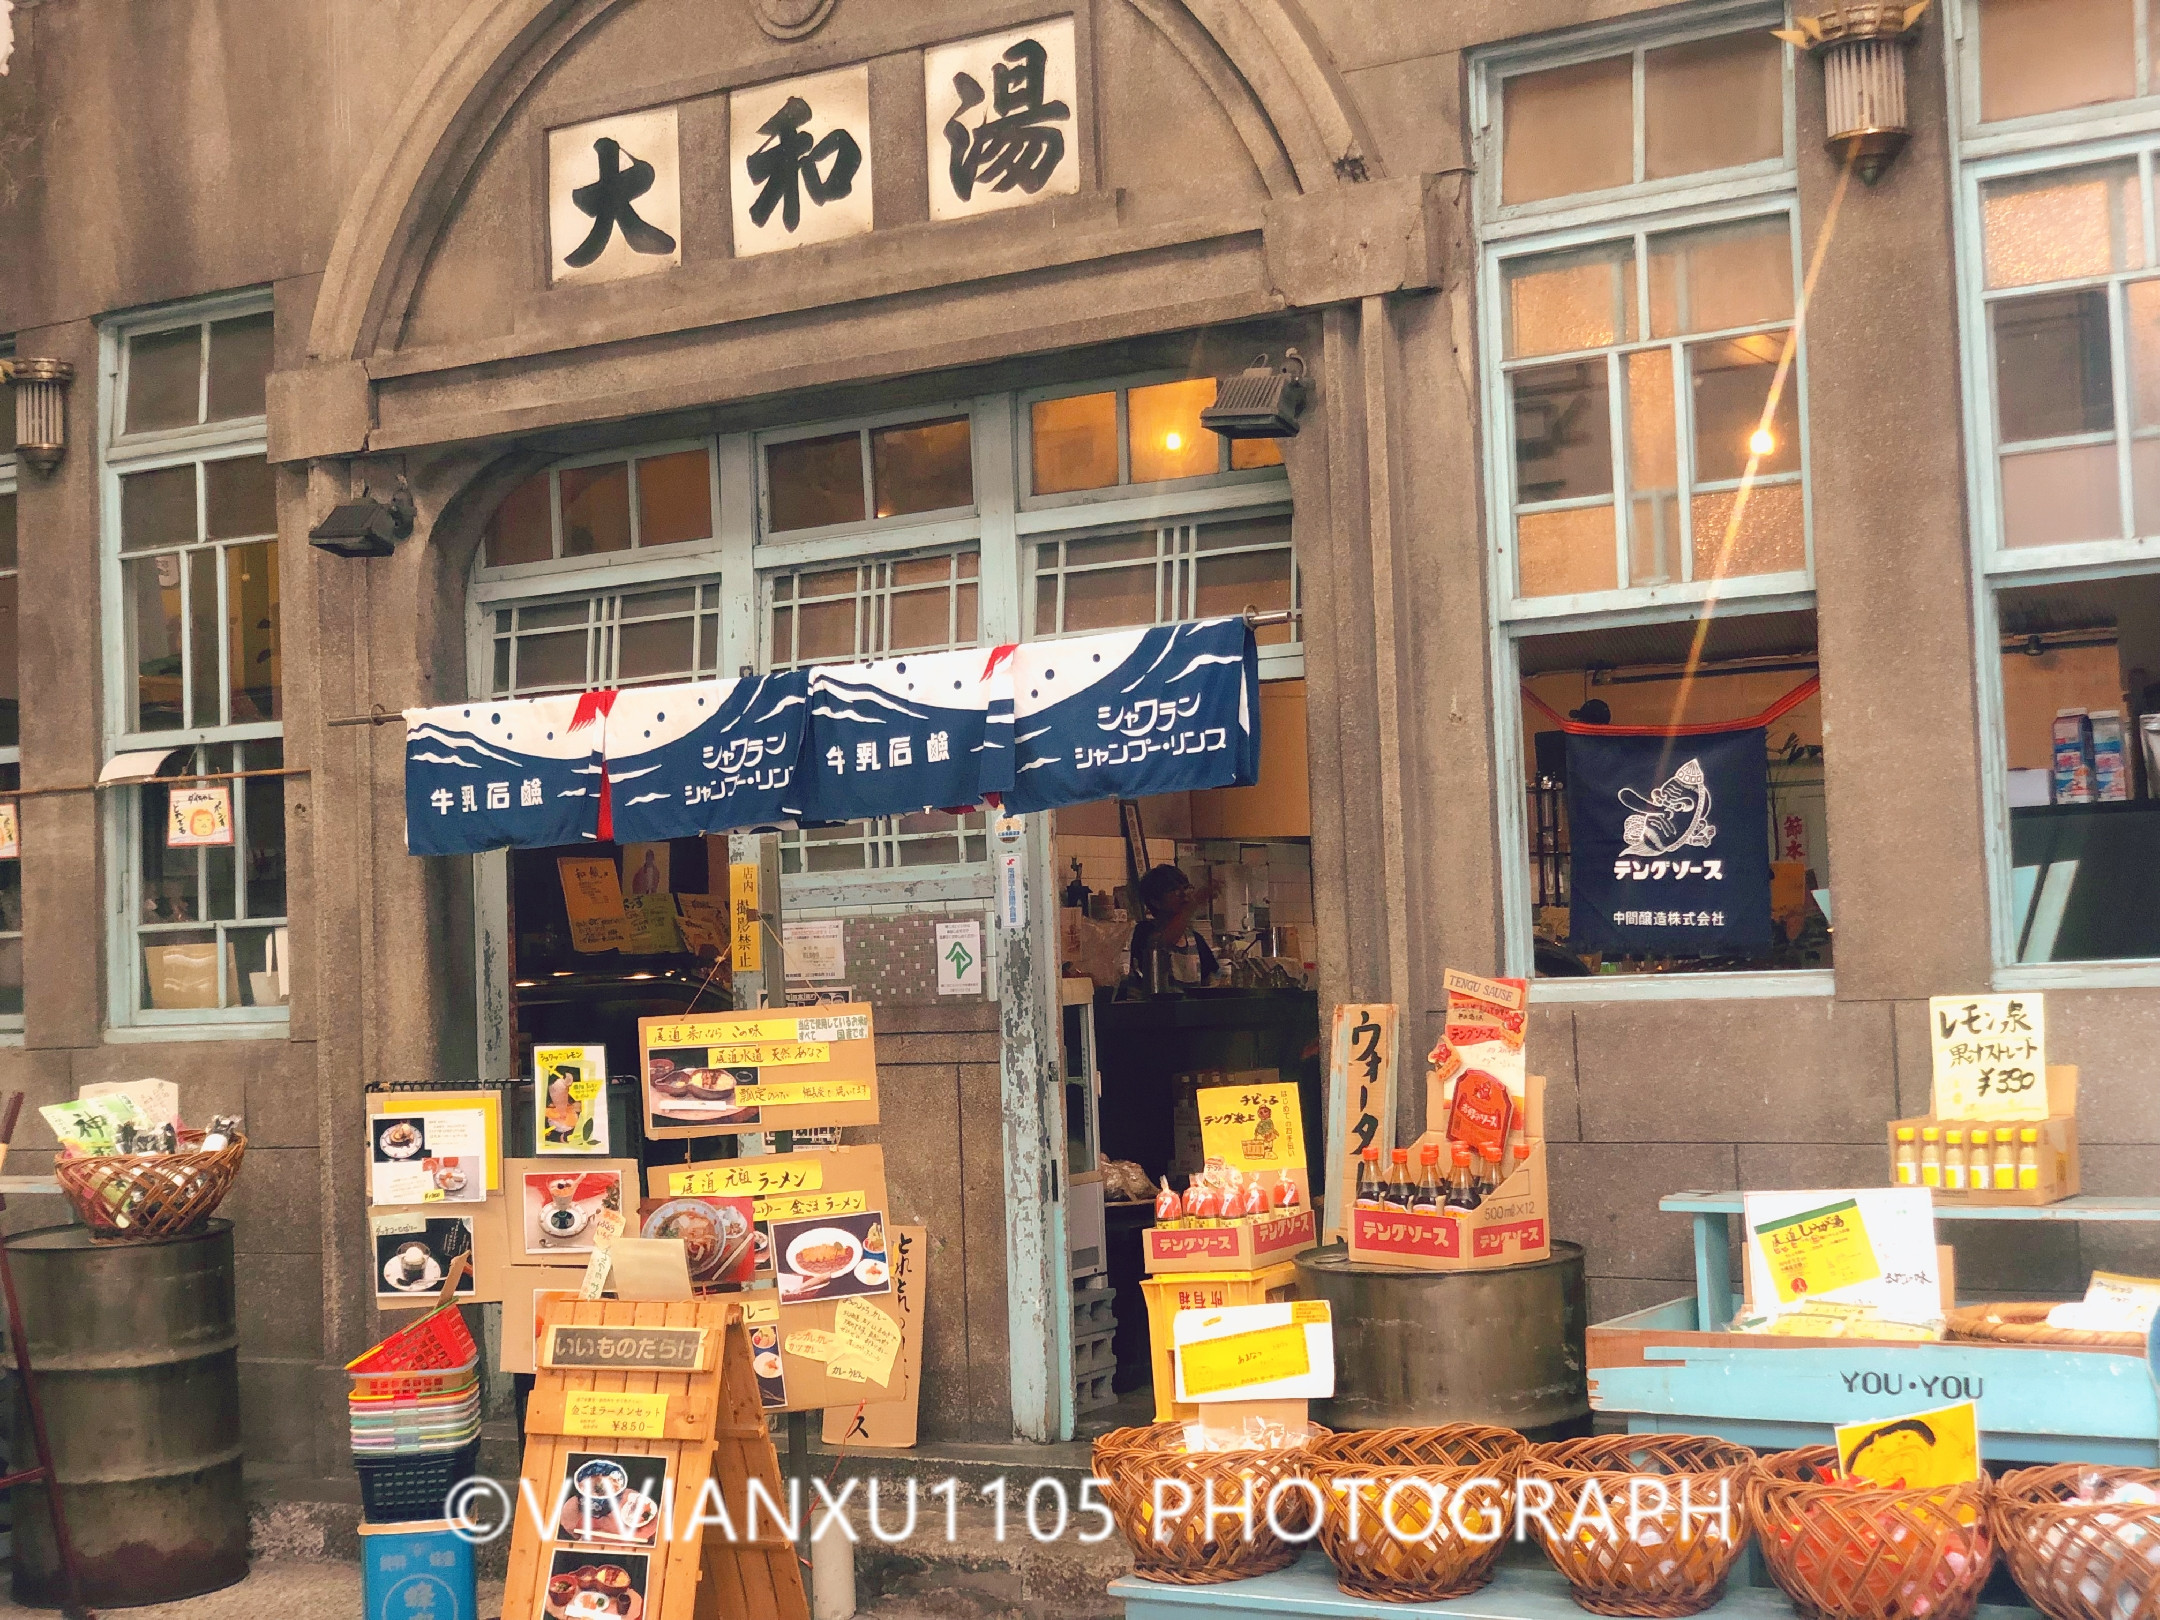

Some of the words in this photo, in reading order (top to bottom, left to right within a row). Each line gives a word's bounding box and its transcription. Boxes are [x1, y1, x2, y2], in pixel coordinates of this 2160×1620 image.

[563, 39, 1071, 269] 大和湯
[1097, 693, 1201, 737] シャワラン
[743, 866, 754, 893] 店内
[1613, 860, 1724, 881] テングソース
[1613, 911, 1725, 927] 中間醸造株式会社
[1449, 975, 1482, 993] TENGU
[1482, 984, 1514, 1002] SAUSE
[1259, 1214, 1310, 1242] テングソース
[1362, 1220, 1449, 1248] テングソース
[1160, 1236, 1232, 1252] テングソース
[555, 1336, 697, 1361] いいものだらけ
